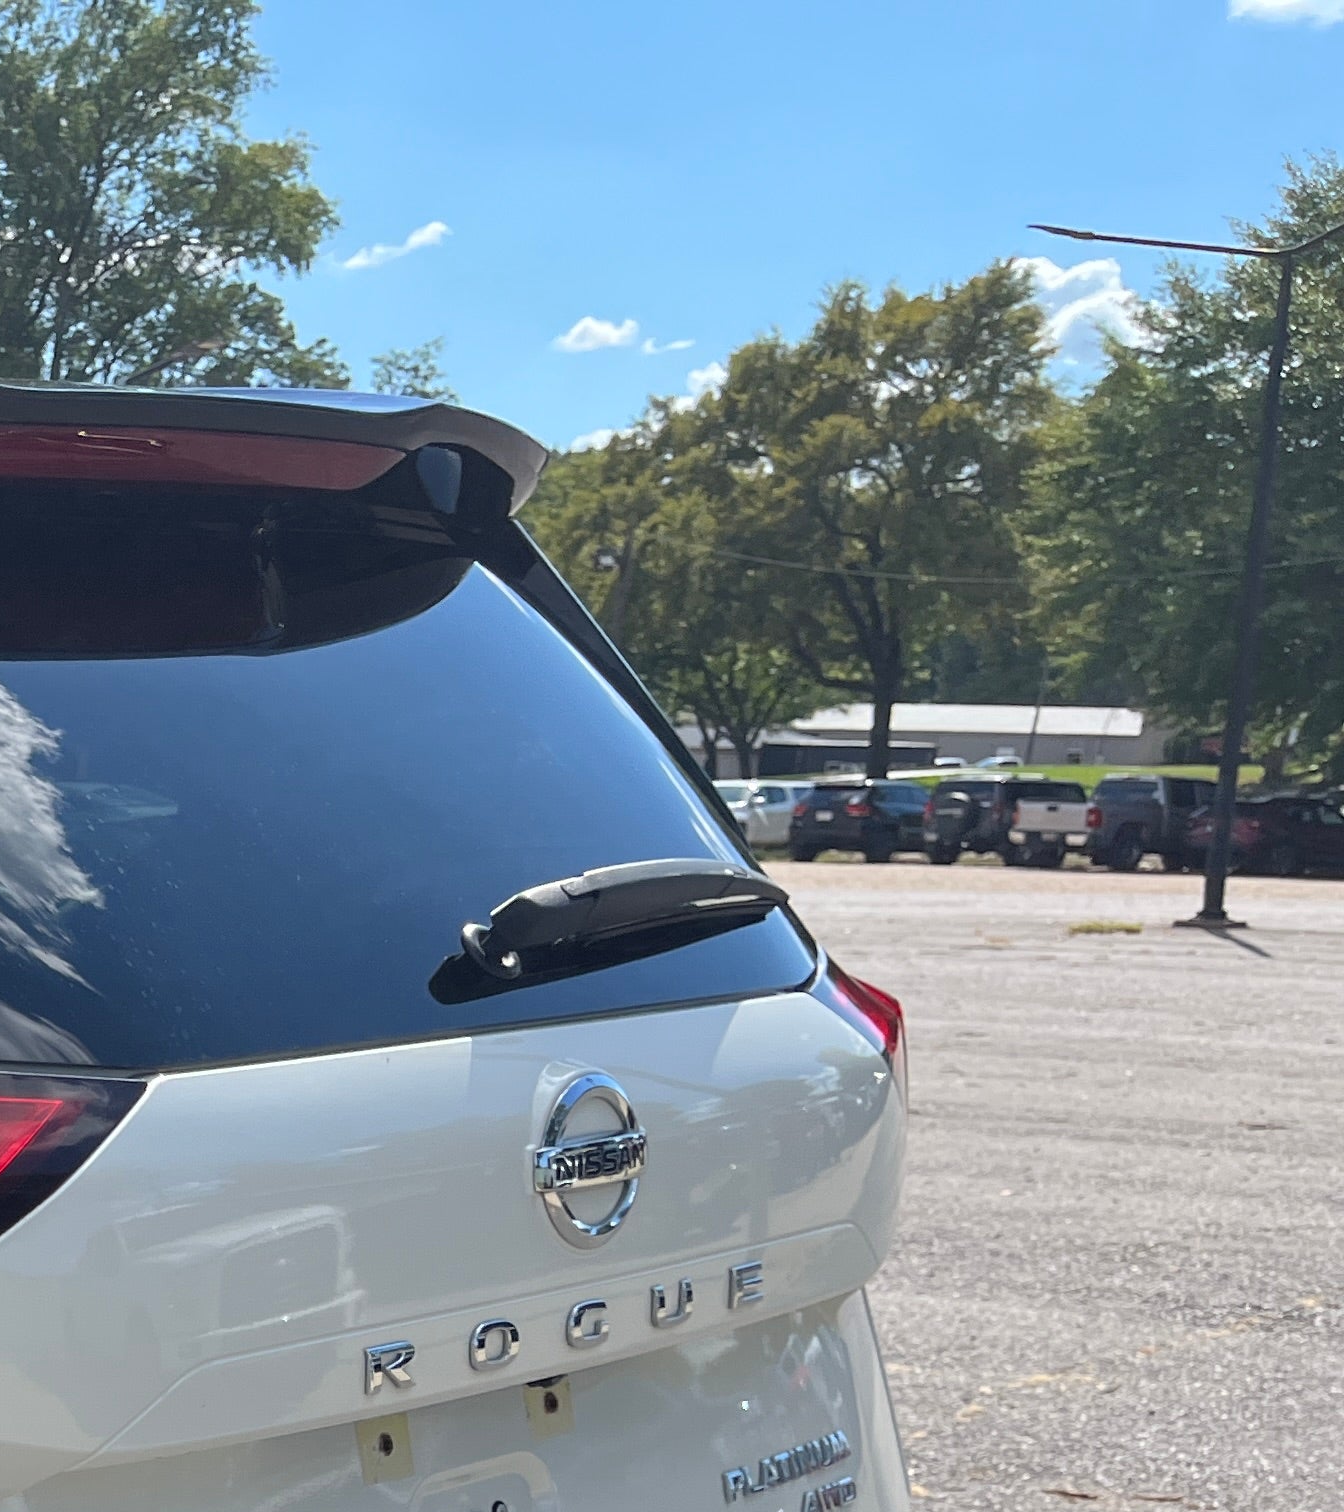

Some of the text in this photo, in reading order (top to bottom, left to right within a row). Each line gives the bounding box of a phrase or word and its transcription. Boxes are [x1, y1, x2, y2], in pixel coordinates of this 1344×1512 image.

[552, 1135, 645, 1181] NISSAN
[364, 1261, 764, 1395] ROGUE
[721, 1429, 851, 1504] PLATINUM
